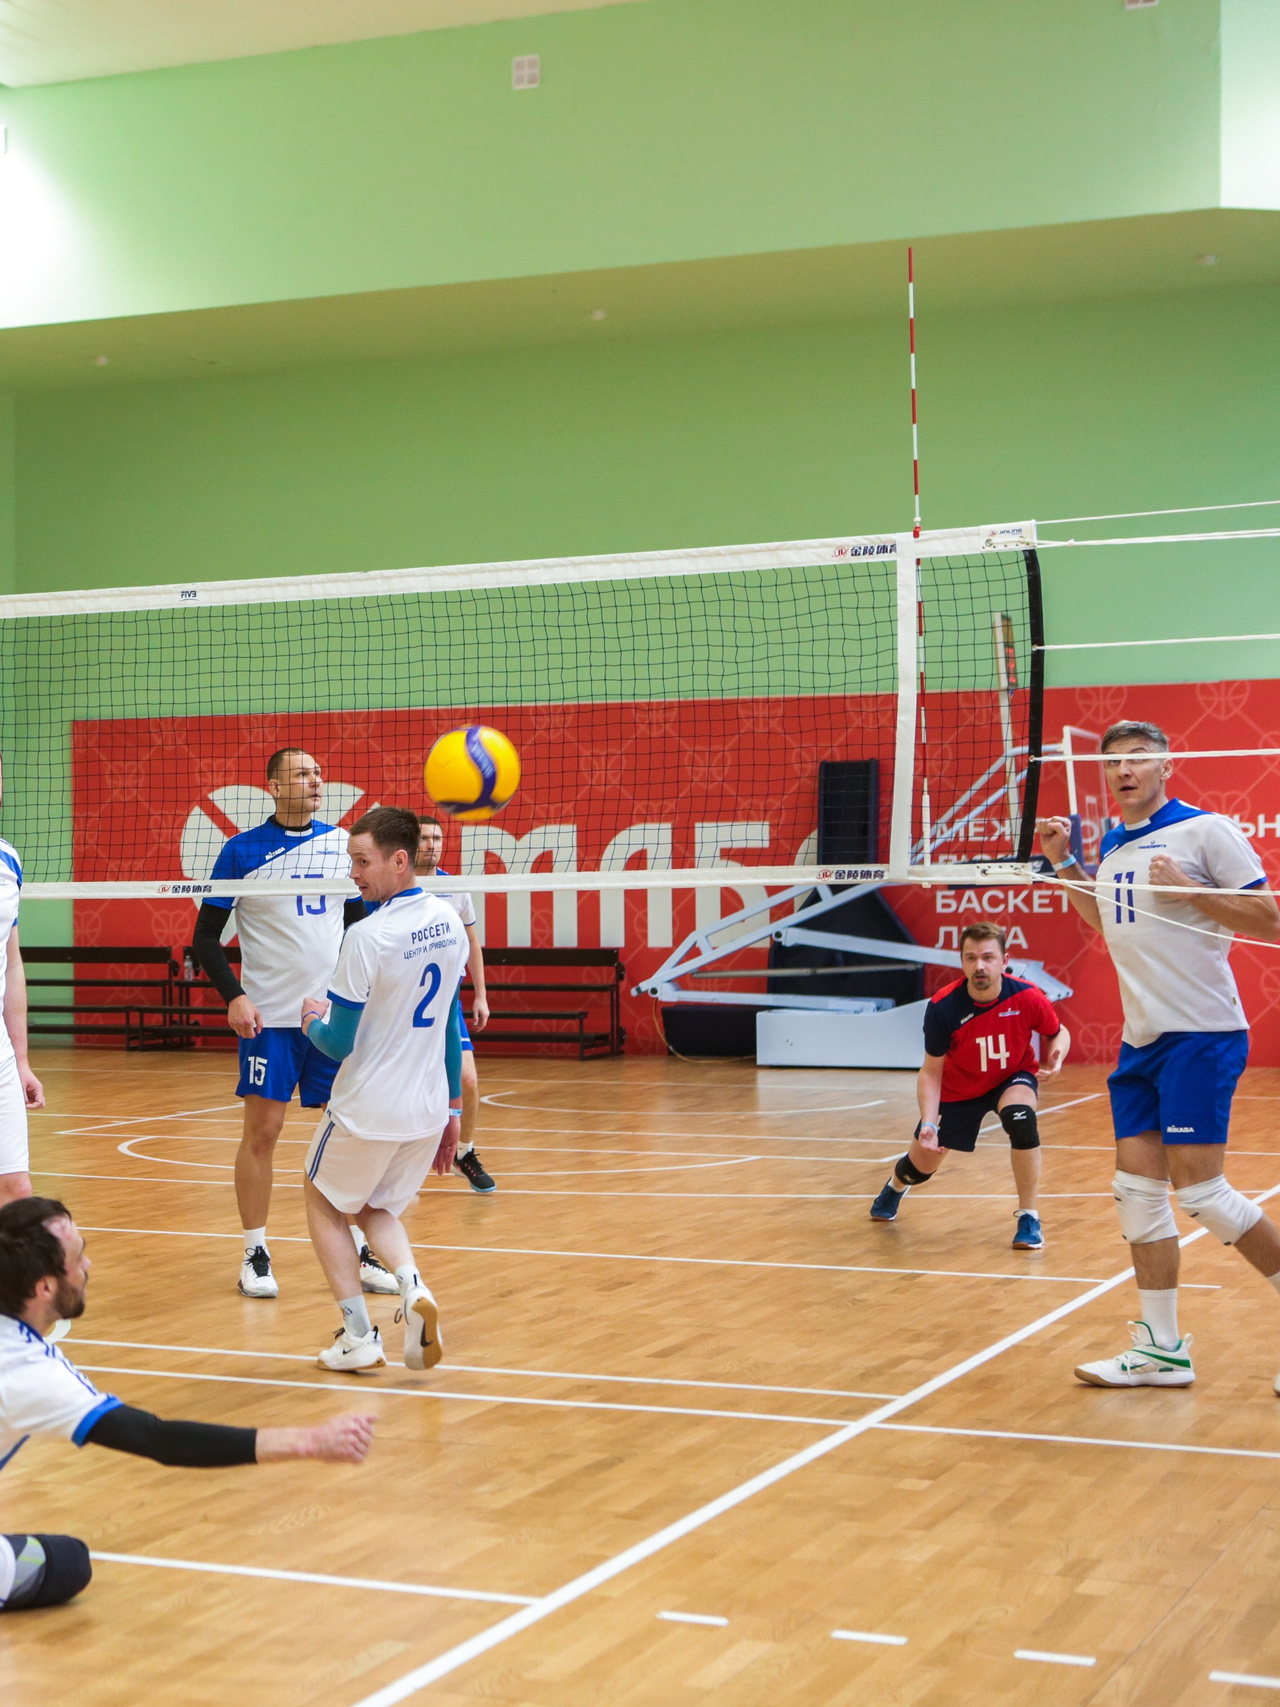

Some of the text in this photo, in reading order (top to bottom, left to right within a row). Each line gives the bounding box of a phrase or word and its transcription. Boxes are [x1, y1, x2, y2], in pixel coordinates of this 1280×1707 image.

[1113, 871, 1136, 924] 11
[411, 921, 451, 945] РОССЕТИ
[403, 946, 422, 960] ЦЕНТР
[412, 962, 442, 1028] 2
[975, 1033, 1010, 1072] 14
[247, 1055, 268, 1086] 15
